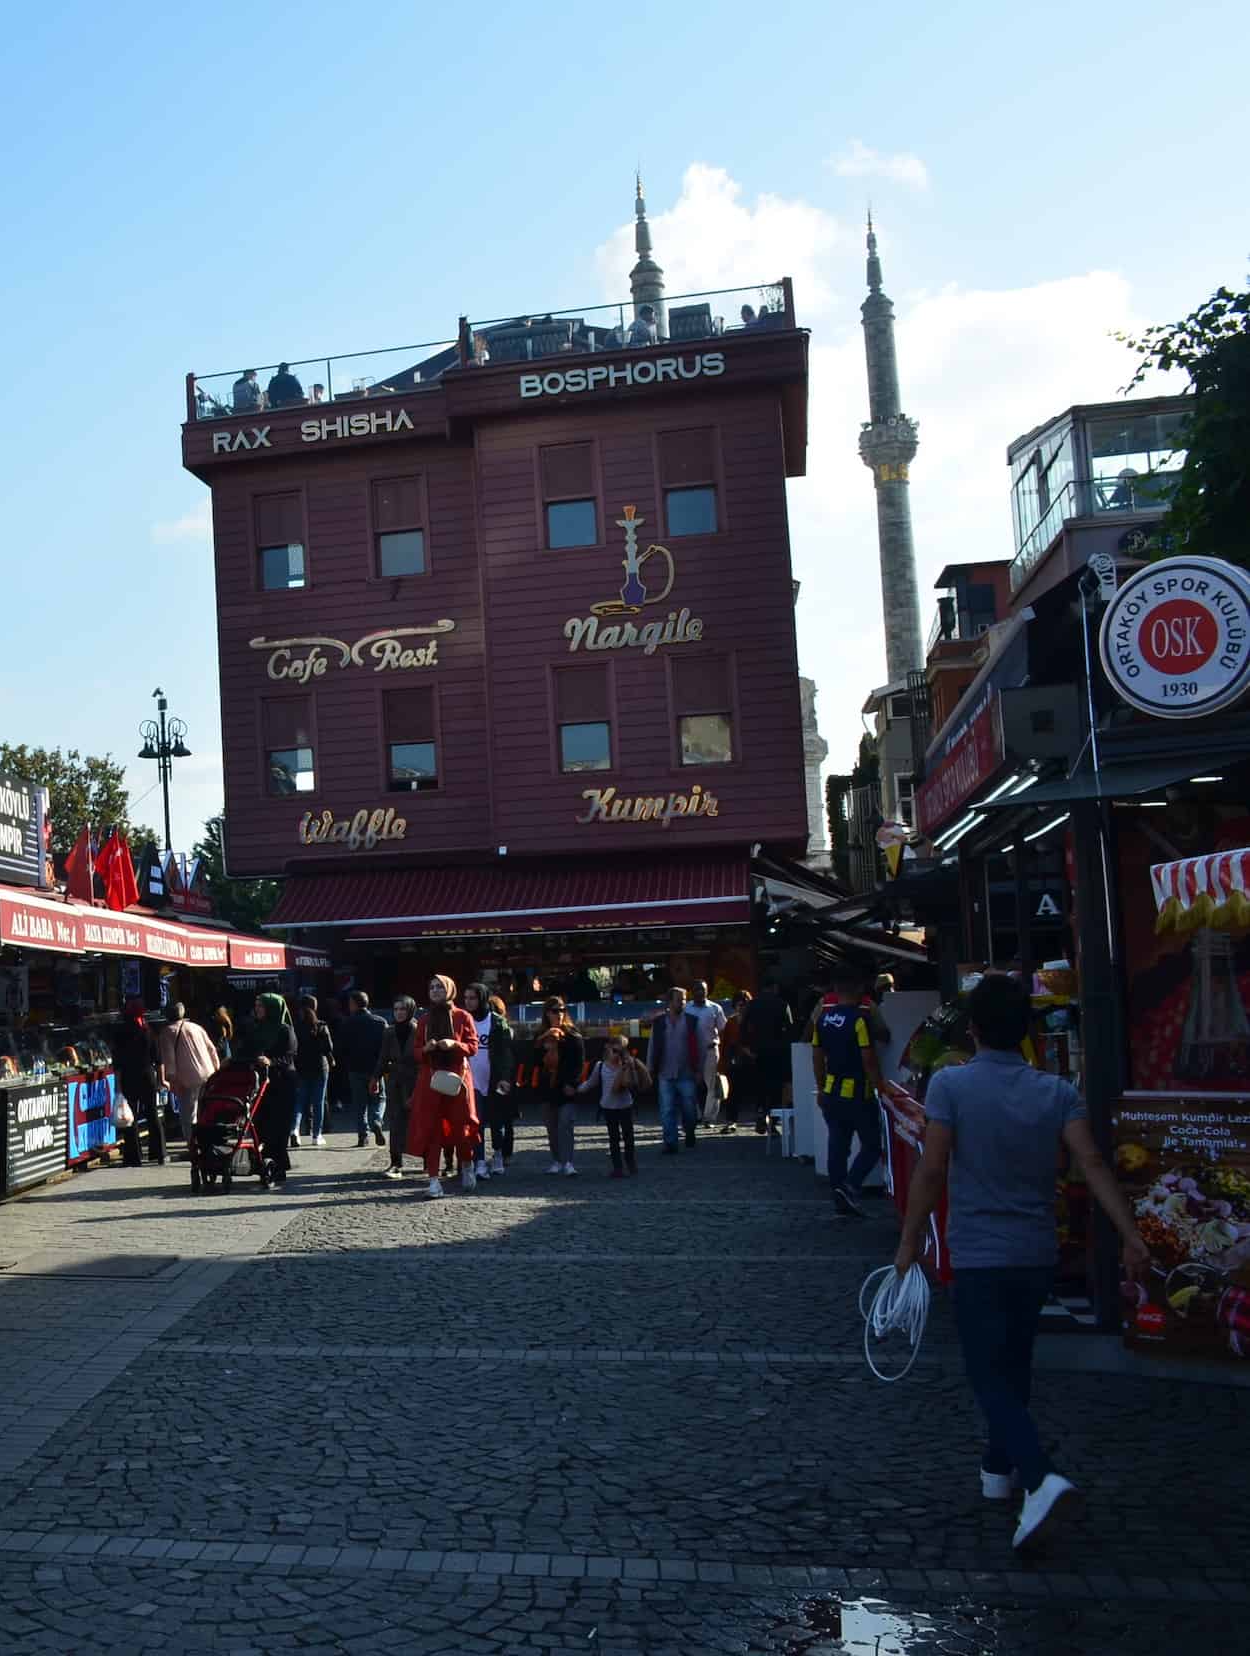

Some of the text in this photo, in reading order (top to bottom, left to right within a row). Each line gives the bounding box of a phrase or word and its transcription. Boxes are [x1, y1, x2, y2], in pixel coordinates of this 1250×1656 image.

[520, 352, 726, 398] BOSPHORUS
[213, 409, 414, 454] RAX SHISHA
[564, 607, 703, 656] Nargile
[1117, 578, 1246, 678] ORTAKÖY SPOR KULÜBÜ
[1151, 616, 1206, 659] OSK
[267, 647, 329, 684] Cafe
[1162, 682, 1199, 697] 1930
[575, 784, 720, 829] Kumpir
[299, 808, 407, 851] Waffle
[17, 1086, 59, 1123] ORTAKÖYLÜ
[25, 1119, 54, 1153] KUMPİR
[1169, 1126, 1231, 1137] Coca-Cola
